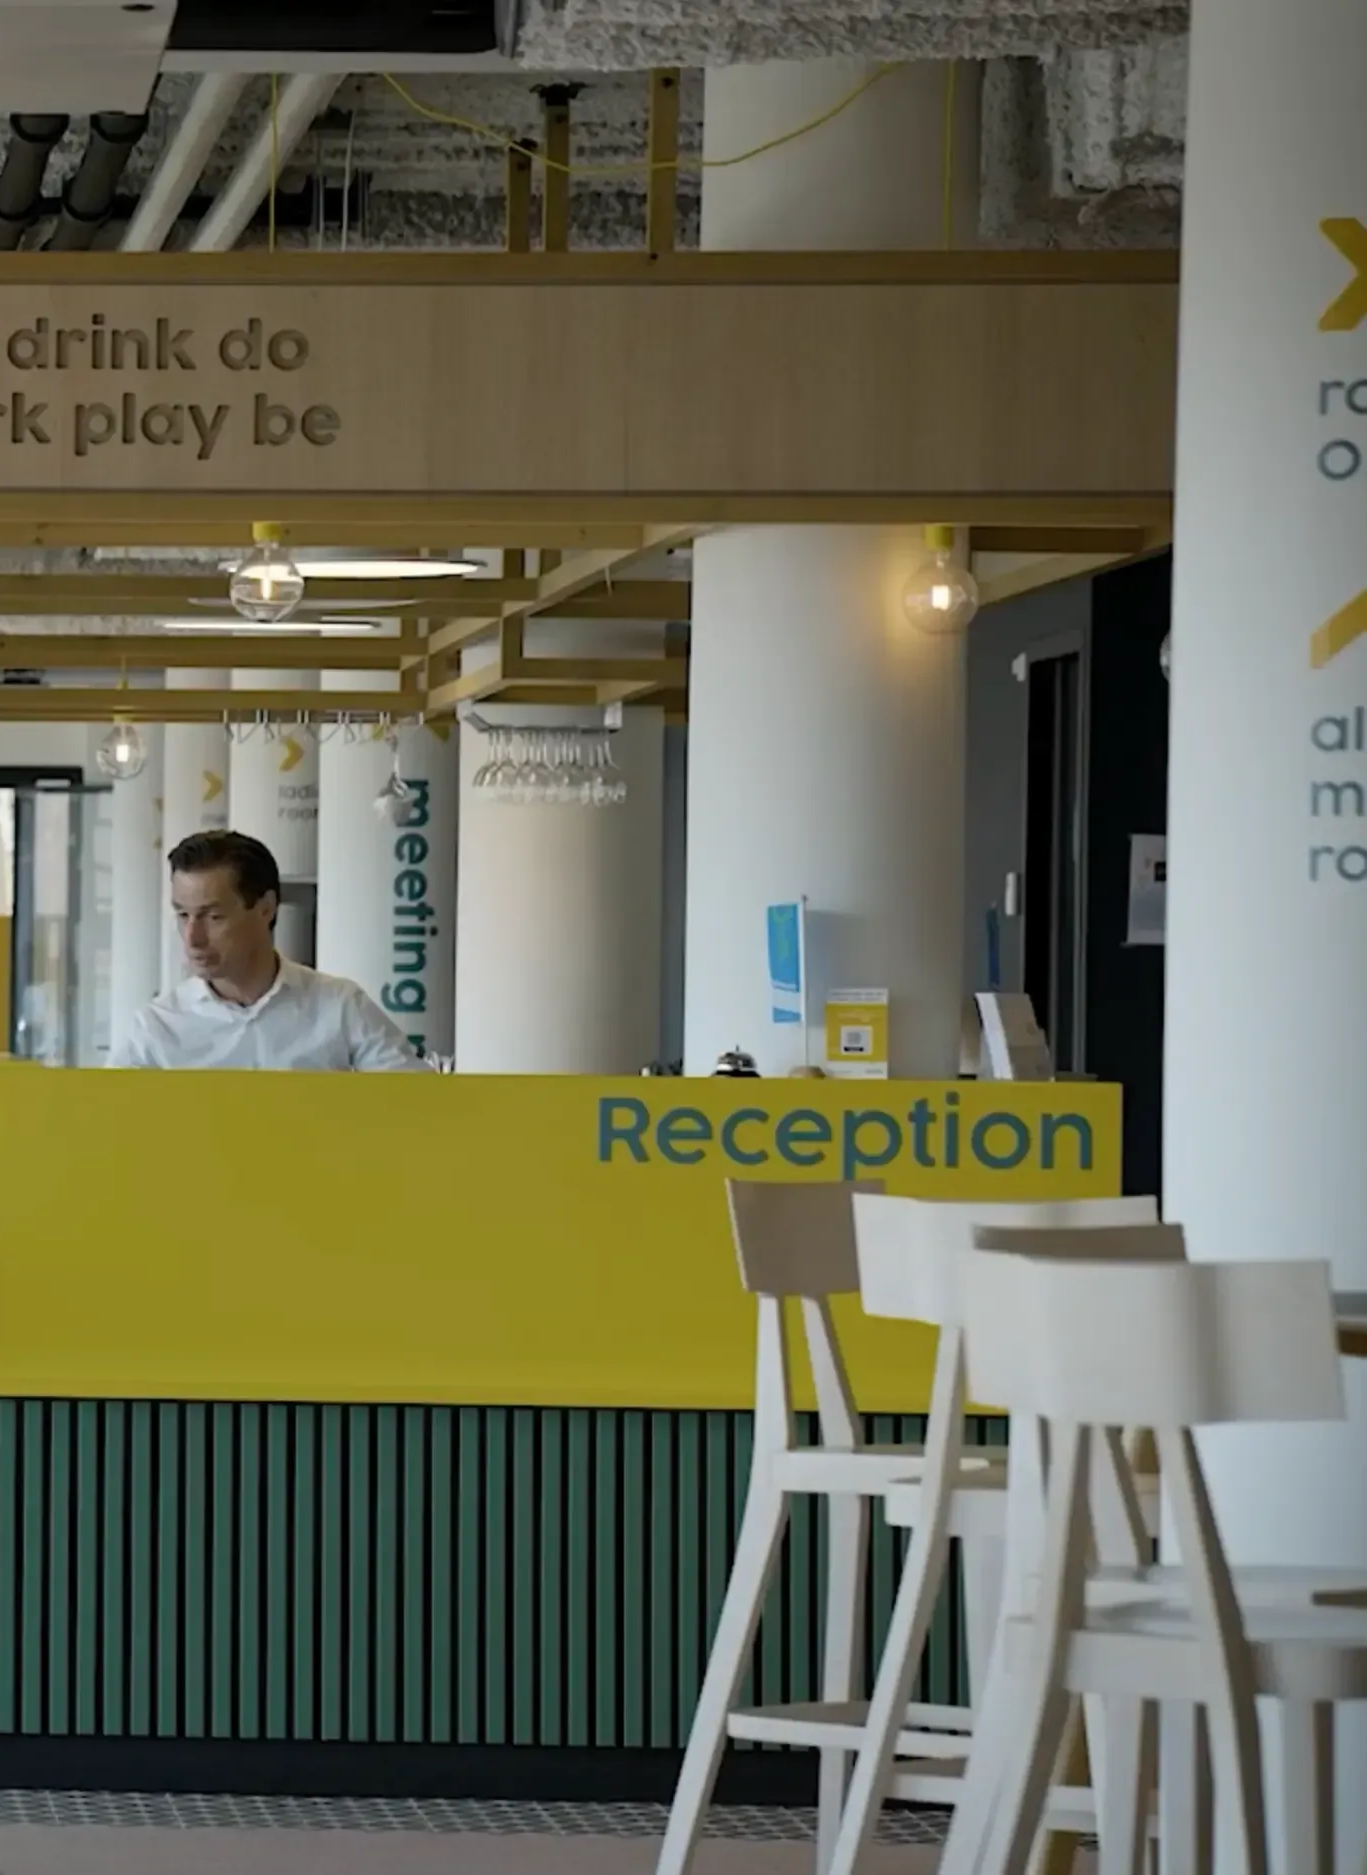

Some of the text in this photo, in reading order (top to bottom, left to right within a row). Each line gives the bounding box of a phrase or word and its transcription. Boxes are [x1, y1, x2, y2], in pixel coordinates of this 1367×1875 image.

[7, 314, 196, 370] drink
[219, 318, 310, 371] do
[74, 393, 231, 460] play
[253, 393, 342, 446] be
[381, 779, 438, 1013] meeting
[597, 1091, 1093, 1181] Reception
